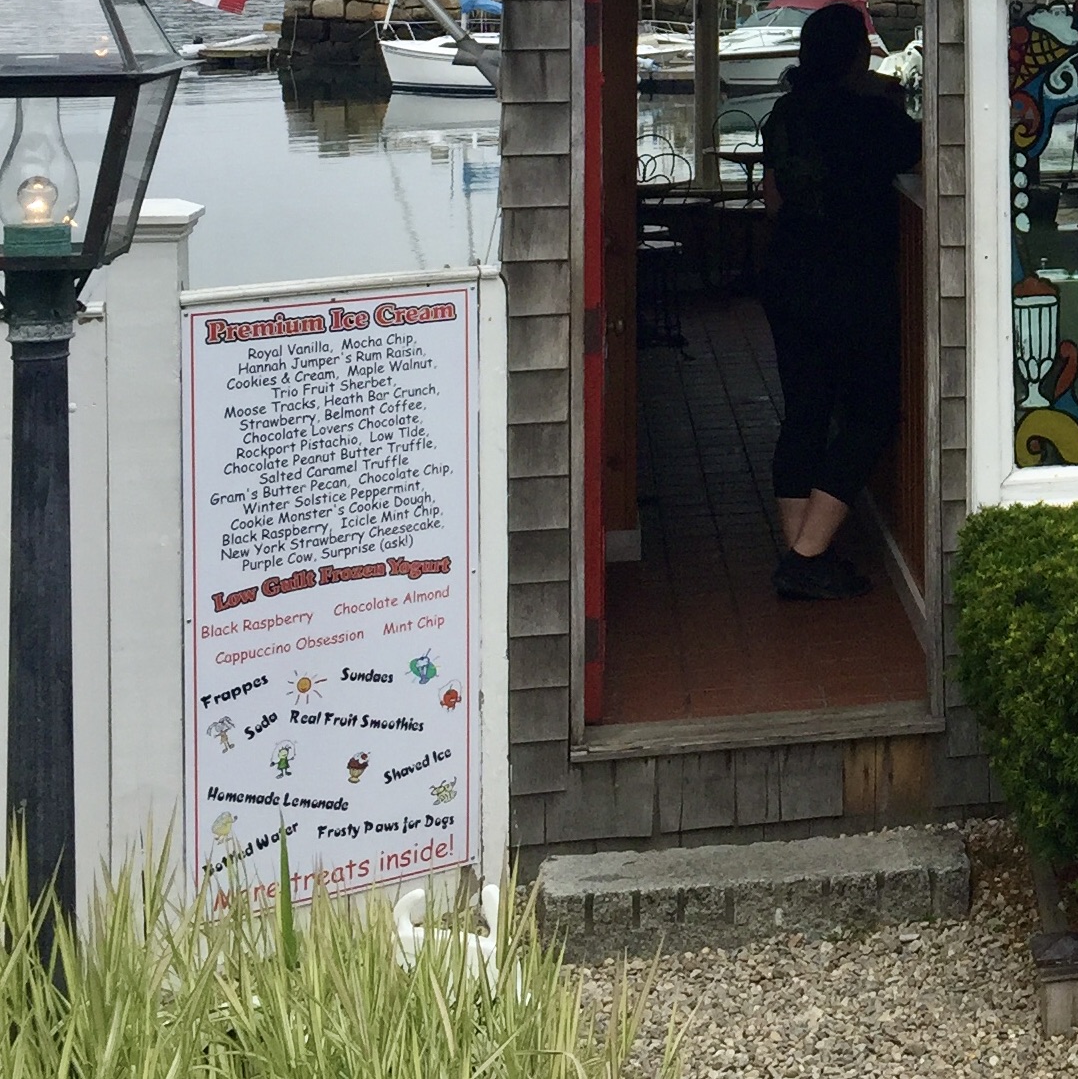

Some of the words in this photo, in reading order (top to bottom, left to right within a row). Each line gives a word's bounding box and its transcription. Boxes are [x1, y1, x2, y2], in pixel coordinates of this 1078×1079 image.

[206, 312, 326, 344] Premium
[329, 307, 370, 332] Ice
[373, 302, 457, 329] Cream
[239, 360, 286, 374] Hannah
[291, 353, 351, 371] Jumper's
[356, 350, 382, 361] Rum
[386, 346, 426, 358] Raisin,
[248, 345, 282, 361] Royal
[288, 342, 333, 356] Vanilla,
[342, 336, 382, 350] Mocha
[386, 334, 417, 346] Chip,
[227, 375, 276, 390] Cookies
[281, 374, 290, 384] &
[294, 370, 339, 382] Cream,
[348, 363, 384, 378] Maple
[390, 358, 437, 372] Walnut,
[272, 386, 298, 399] Trio
[303, 382, 334, 395] Fruit
[340, 376, 396, 391] Sherbet,
[224, 405, 266, 418] Moose
[272, 399, 320, 413] Tracks,
[324, 393, 363, 406] Heath
[368, 390, 389, 401] Bar
[393, 384, 440, 398] Crunch,
[240, 413, 320, 431] Strawberry,
[325, 406, 375, 421] Belmont
[380, 400, 426, 414] Coffee,
[236, 442, 296, 460] Rockport
[301, 435, 362, 451] Pistachio,
[370, 431, 393, 442] Low
[398, 426, 429, 438] Tide,
[243, 428, 308, 444] Chocolate
[312, 422, 354, 436] Lovers
[358, 413, 423, 430] Chocolate,
[224, 457, 288, 475] Chocolate
[293, 451, 336, 466] Peanut
[340, 446, 382, 458] Butter
[387, 438, 437, 453] Truffle,
[260, 471, 302, 485] Salted
[306, 462, 357, 478] Caramel
[362, 455, 409, 470] Truffle
[210, 488, 258, 506] Gram's
[263, 484, 306, 499] Butter
[310, 477, 350, 492] Pecan,
[358, 468, 420, 485] Chocolate
[424, 463, 453, 476] Chip,
[243, 500, 290, 515] Winter
[295, 491, 346, 508] Solstice
[351, 481, 424, 500] Peppermint,
[222, 532, 258, 546] Black
[262, 522, 332, 542] Raspberry,
[342, 513, 376, 529] Icicle
[381, 507, 409, 521] Mint
[413, 504, 443, 518] Chip,
[231, 516, 274, 531] Cookie
[278, 504, 344, 524] Monster's
[349, 500, 389, 513] Cookie
[394, 494, 435, 508] Dough,
[221, 547, 250, 561] New
[254, 540, 286, 555] York
[290, 528, 365, 551] Strawberry
[369, 518, 444, 538] Cheesecake,
[242, 556, 283, 572] Purple
[288, 551, 317, 564] Cow,
[322, 542, 376, 560] Surprise
[212, 588, 259, 612] Low
[261, 569, 316, 596] Guilt
[319, 560, 386, 584] Frozen
[389, 556, 451, 580] Yogurt
[334, 597, 398, 617] Chocolate
[403, 586, 450, 605] Almond
[201, 619, 239, 639] Black
[243, 611, 313, 632] Raspberry
[383, 618, 413, 636] Mint
[417, 615, 445, 630] Chip
[215, 640, 291, 666] Cappuccino
[296, 629, 364, 651] Obsession
[340, 667, 393, 683] Sundaes
[201, 674, 269, 709] Frappes
[244, 712, 277, 740] Soda
[290, 710, 321, 724] Real
[324, 713, 357, 727] Fruit
[360, 714, 424, 732] Smoothies
[383, 754, 430, 785] Shaved
[433, 748, 451, 765] Ice
[207, 787, 280, 806] Homemade
[283, 793, 349, 811] Lemonade
[255, 822, 299, 849] Waer
[318, 822, 359, 840] Frosty
[364, 820, 399, 835] Paws
[402, 817, 422, 834] for
[425, 814, 454, 831] Dogs
[213, 880, 279, 910] Mre
[290, 858, 369, 893] treats
[379, 833, 454, 871] inside!
